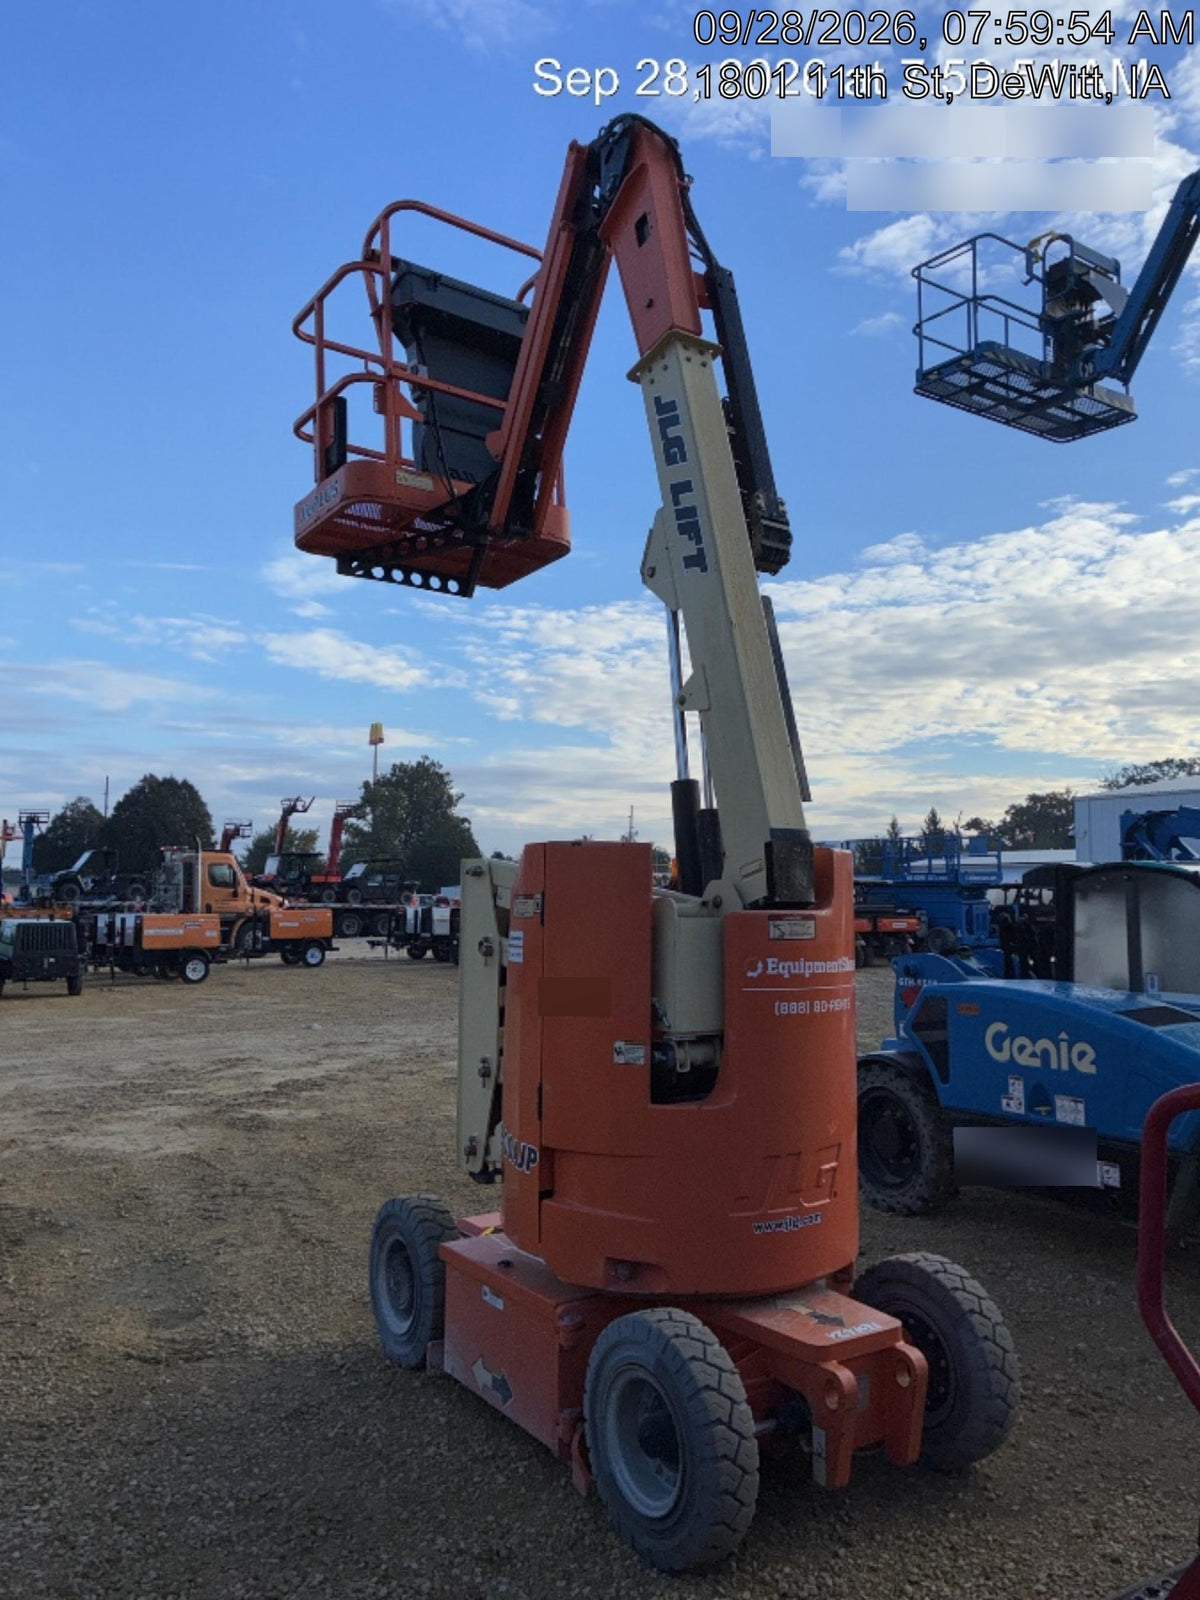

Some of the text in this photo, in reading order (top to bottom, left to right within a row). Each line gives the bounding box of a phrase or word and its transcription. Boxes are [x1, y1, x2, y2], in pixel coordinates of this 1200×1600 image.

[653, 395, 709, 573] JLG LIFT
[984, 1022, 1097, 1075] Genie
